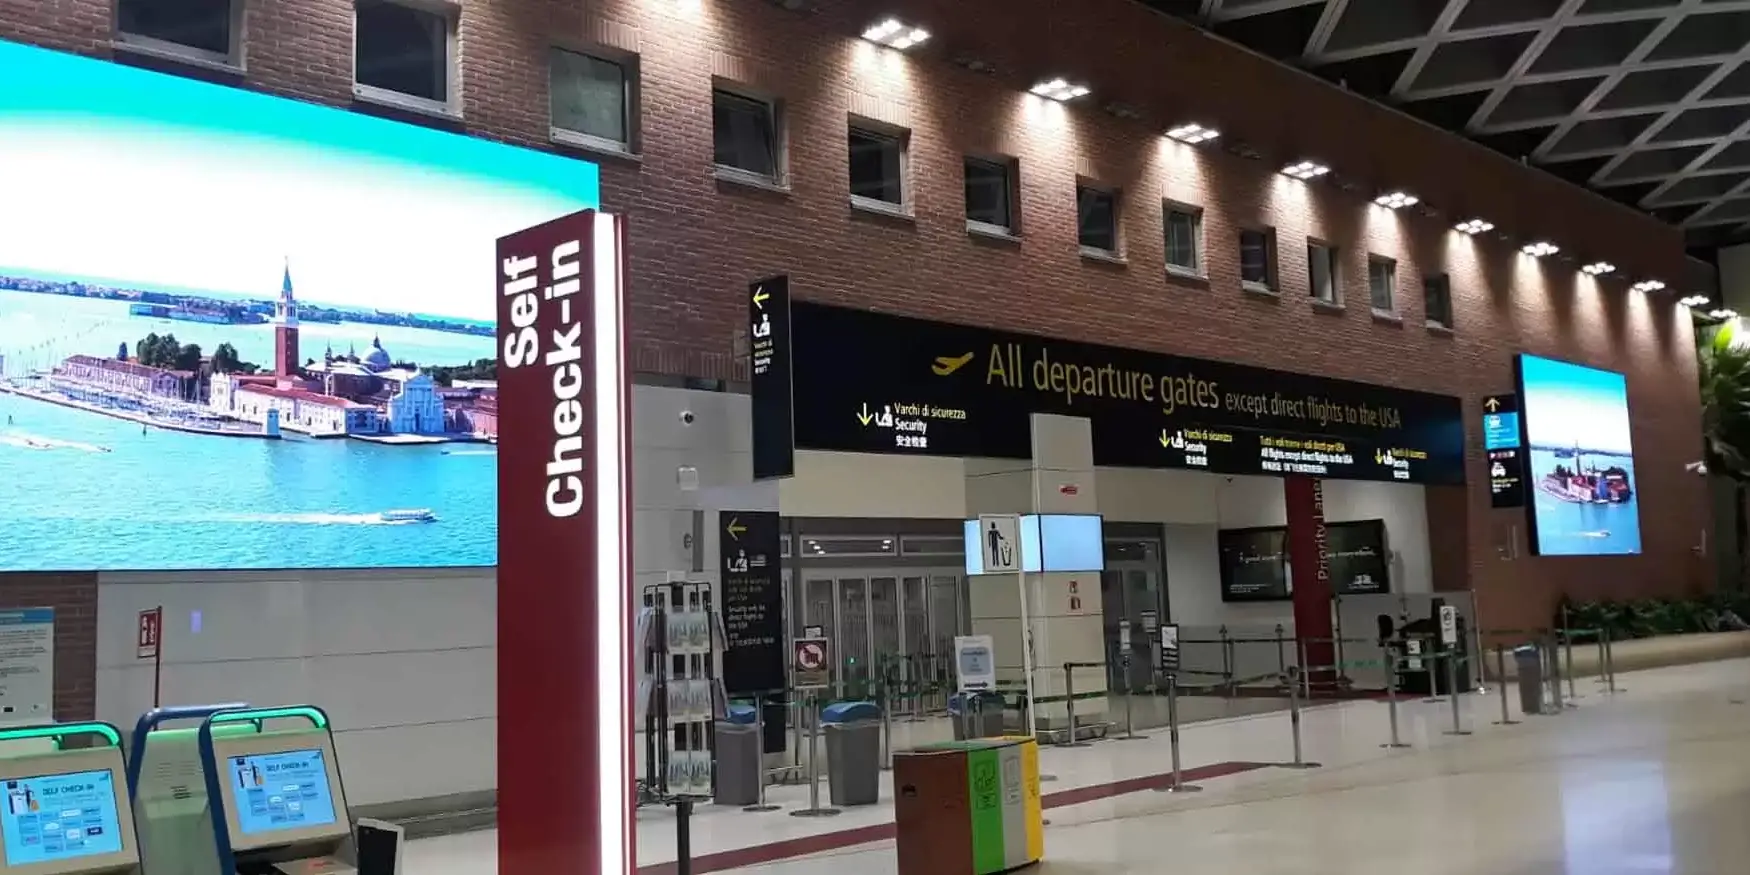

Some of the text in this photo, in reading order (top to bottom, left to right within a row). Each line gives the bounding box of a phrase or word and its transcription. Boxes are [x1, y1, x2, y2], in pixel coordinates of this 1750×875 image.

[503, 254, 539, 368] Self
[545, 239, 583, 518] Check-in
[894, 402, 966, 420] Varchi di sicurezza
[987, 343, 1402, 429] All departure gates except direct flights to the USA
[895, 417, 928, 435] Security
[1314, 524, 1328, 580] Priority
